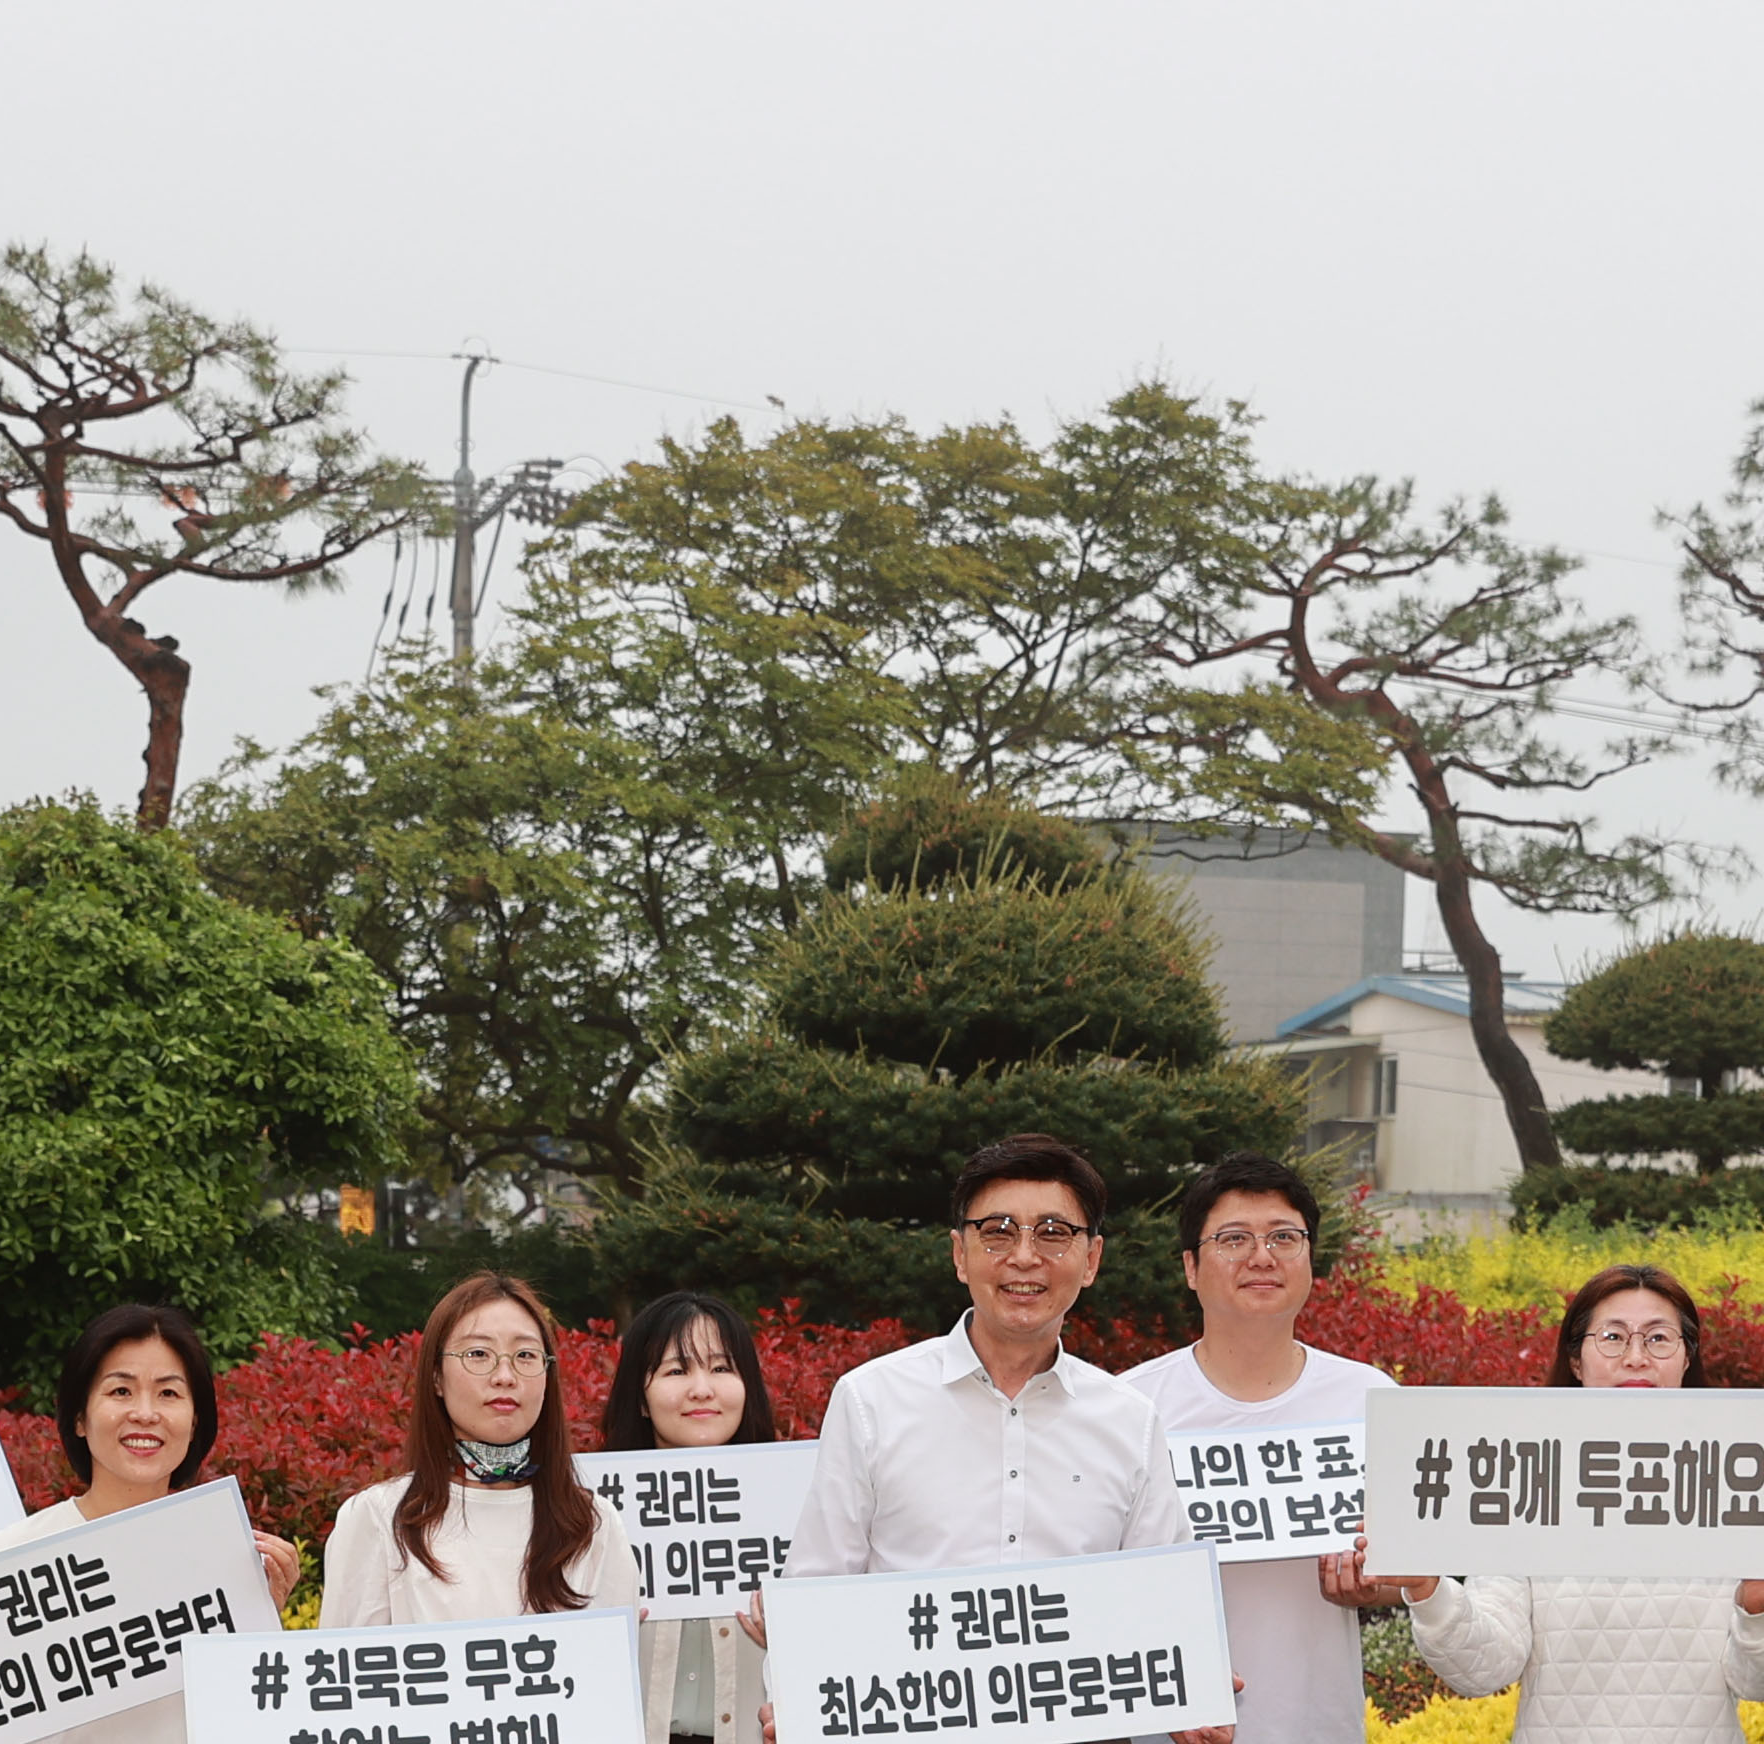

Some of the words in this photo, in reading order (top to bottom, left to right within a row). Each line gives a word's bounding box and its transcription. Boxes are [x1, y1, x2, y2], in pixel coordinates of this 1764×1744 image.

[635, 1468, 741, 1528] 권리는
[1169, 1442, 1249, 1489] 나의
[1257, 1439, 1303, 1484] 한
[1413, 1438, 1453, 1520] #
[1467, 1437, 1561, 1526] 함께
[908, 1593, 939, 1651] #
[951, 1583, 1070, 1651] 권리는
[251, 1651, 290, 1711] #
[304, 1642, 449, 1712] 침묵은
[465, 1634, 575, 1703] 무효,
[818, 1664, 978, 1737] 최소한의
[988, 1645, 1187, 1725] 의무로부터
